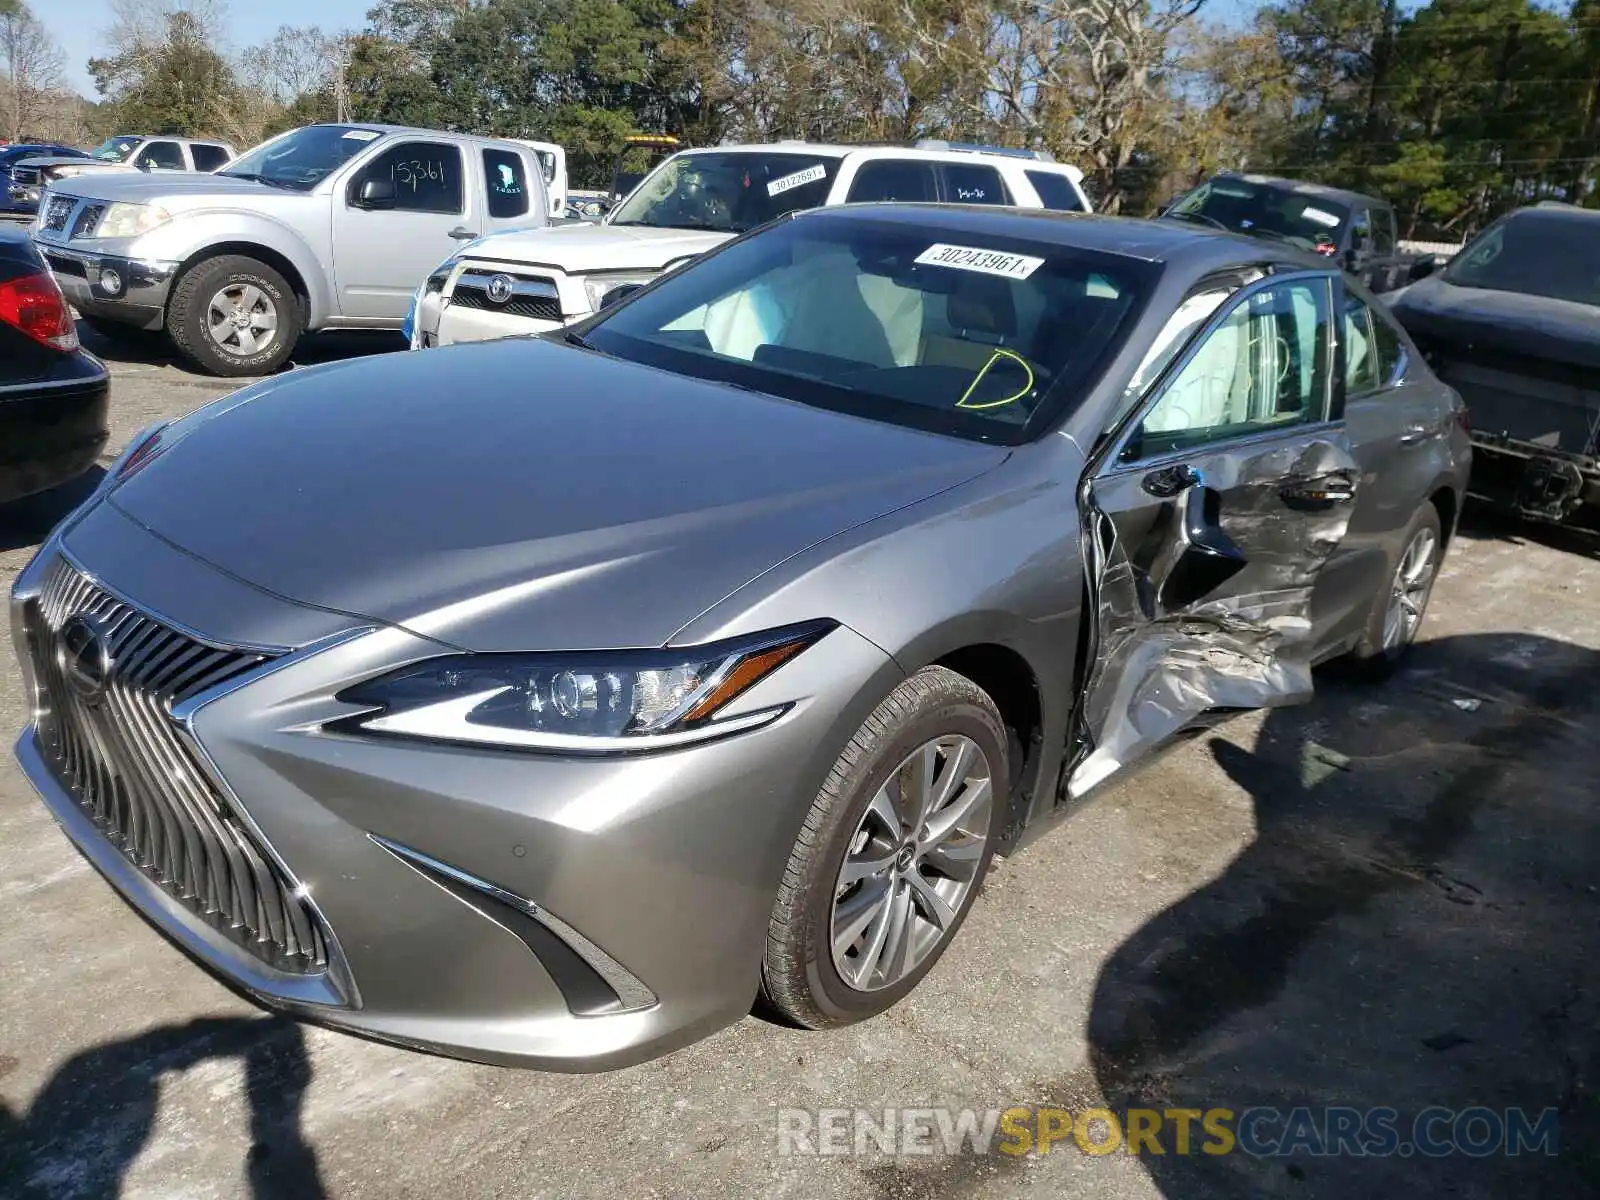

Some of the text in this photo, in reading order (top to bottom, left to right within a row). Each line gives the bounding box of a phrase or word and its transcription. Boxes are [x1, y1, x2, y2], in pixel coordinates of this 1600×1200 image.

[391, 160, 445, 192] 15,361
[933, 247, 1025, 272] 30243961
[954, 347, 1034, 409] D
